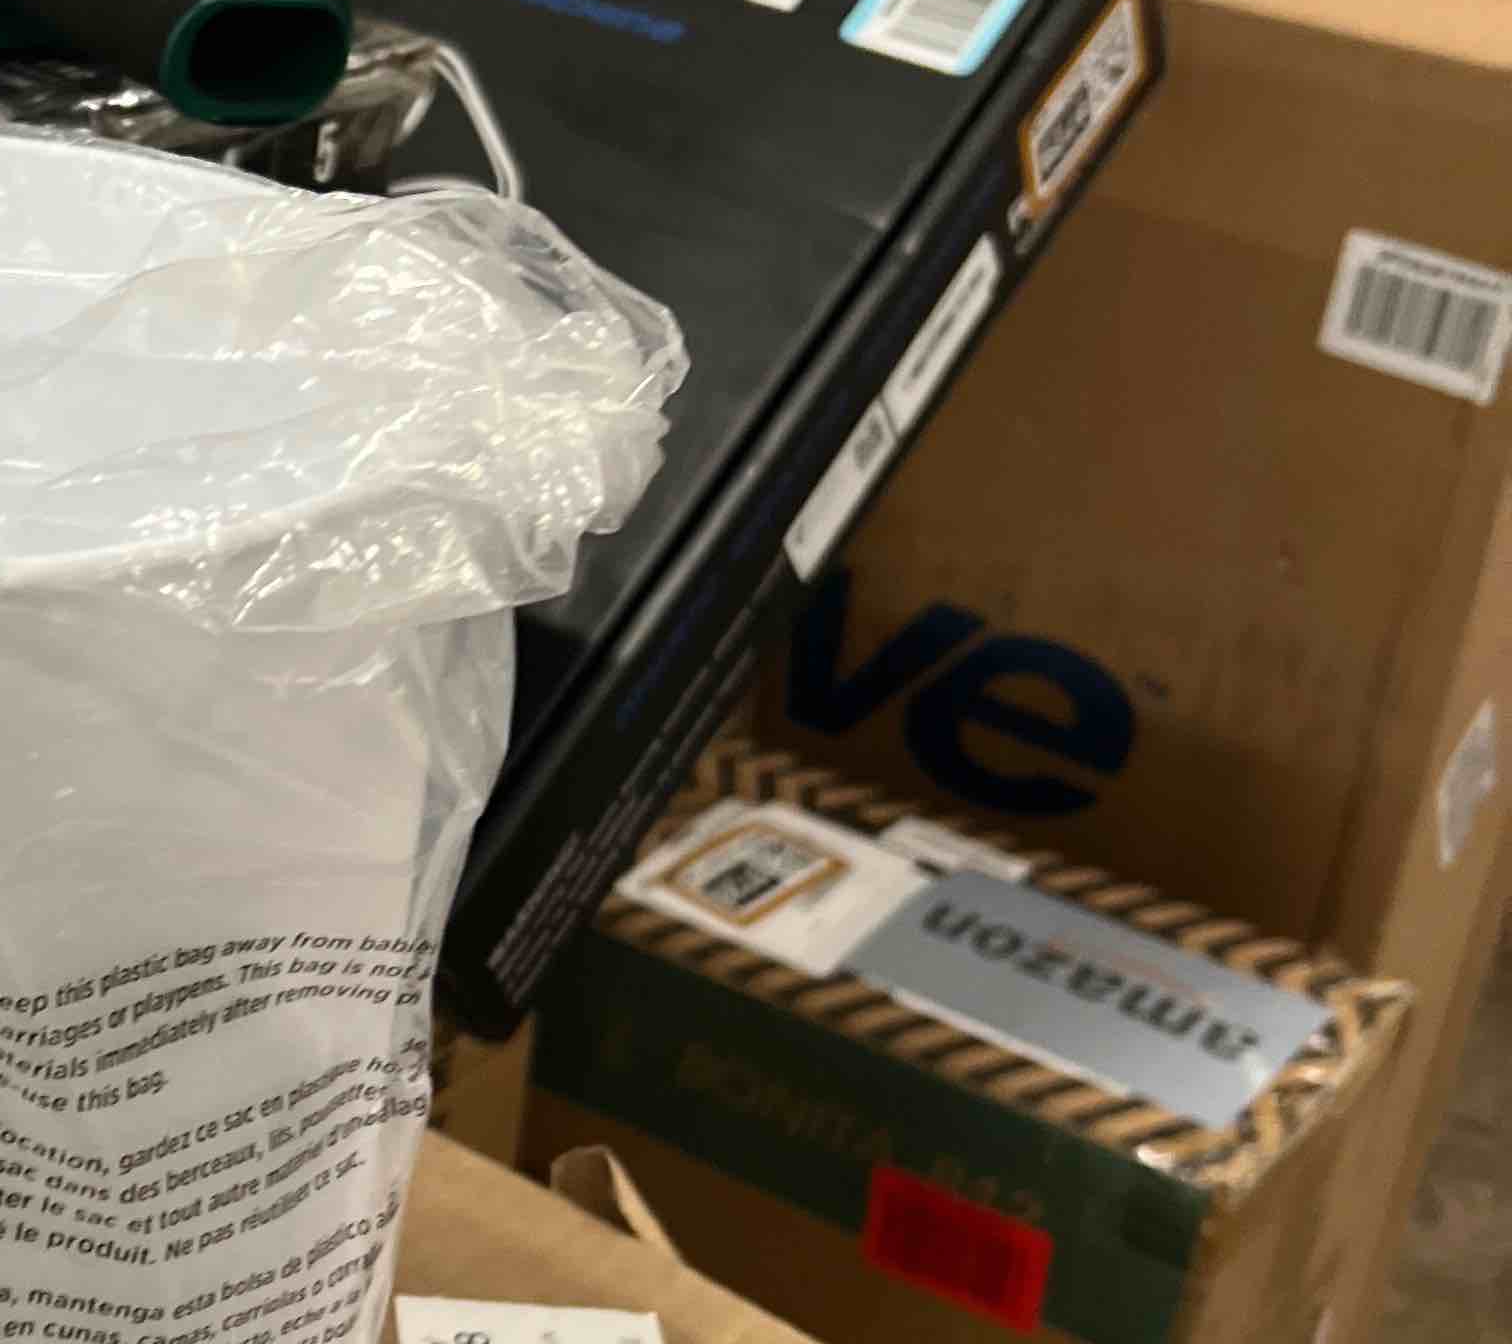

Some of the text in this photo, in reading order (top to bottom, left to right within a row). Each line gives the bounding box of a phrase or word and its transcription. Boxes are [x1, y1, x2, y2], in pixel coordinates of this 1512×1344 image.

[55, 977, 95, 1008] this
[100, 954, 169, 998] plastic
[174, 944, 217, 969] bag
[221, 934, 287, 957] away
[291, 931, 354, 952] from
[918, 897, 1264, 1064] amazon
[107, 1006, 129, 1029] or
[238, 960, 284, 984] This
[288, 956, 337, 976] bag
[341, 958, 364, 975] is
[368, 962, 415, 979] not
[275, 982, 393, 1006] removing
[76, 1083, 121, 1114] this
[117, 1130, 192, 1176] gardez
[194, 1120, 219, 1143] ce
[223, 1104, 257, 1133] sac
[44, 1174, 111, 1202] dans
[118, 1178, 162, 1205] des
[39, 1197, 66, 1216] le
[72, 1208, 119, 1229] sac
[126, 1214, 154, 1235] et
[158, 1197, 203, 1231] tout
[14, 1221, 40, 1243] le
[45, 1230, 157, 1266] produit.
[163, 1236, 194, 1262] Ne
[198, 1221, 236, 1253] pas
[27, 1287, 166, 1326] mantenga
[171, 1291, 218, 1320] esta
[221, 1268, 277, 1302] bolsa
[280, 1255, 304, 1280] de
[3, 1318, 36, 1338] en
